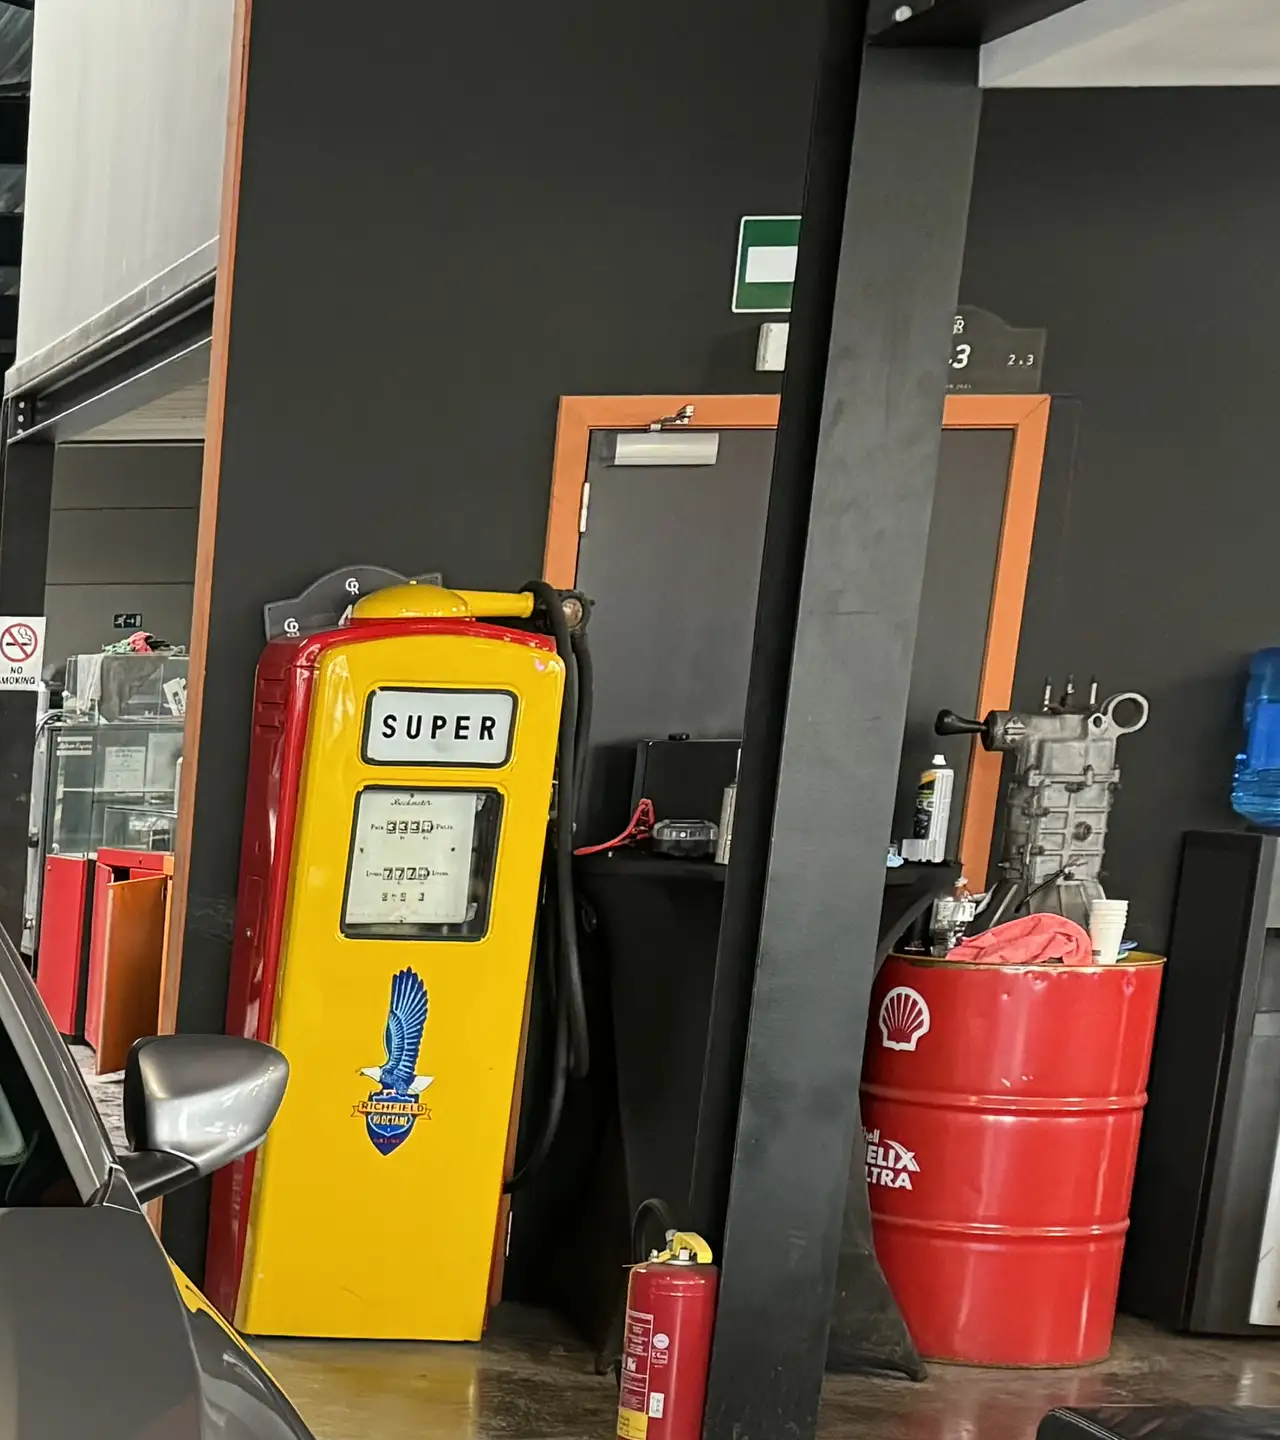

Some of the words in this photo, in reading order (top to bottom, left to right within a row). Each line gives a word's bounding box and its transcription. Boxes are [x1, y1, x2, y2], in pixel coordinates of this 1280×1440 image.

[10, 666, 23, 675] NO
[381, 714, 496, 740] SUPER
[361, 1102, 424, 1113] RICHFIELD
[863, 1127, 880, 1143] hell
[865, 1165, 913, 1191] LTRA
